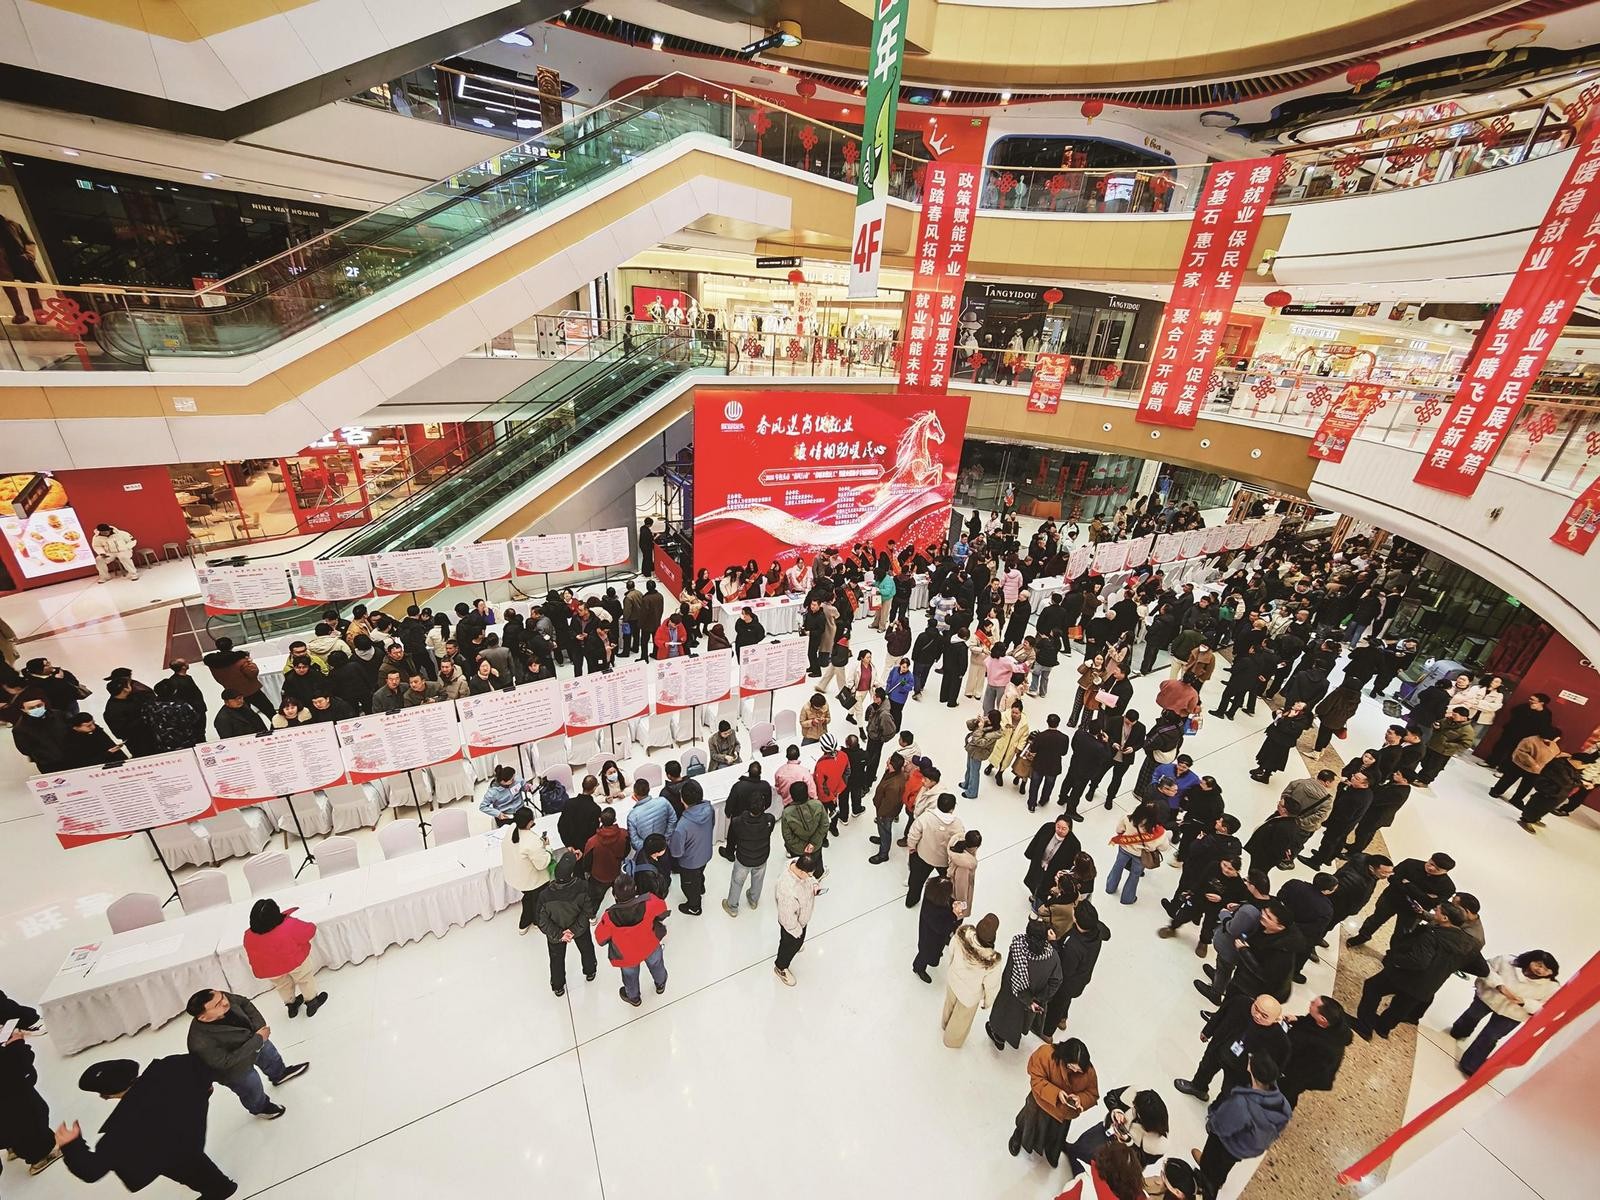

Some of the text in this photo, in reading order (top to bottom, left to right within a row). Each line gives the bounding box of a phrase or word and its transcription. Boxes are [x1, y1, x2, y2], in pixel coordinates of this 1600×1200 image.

[345, 266, 360, 278] 2F
[853, 217, 882, 274] 4F
[905, 169, 947, 387] 马踏春风拓路 就业赋能未来
[929, 172, 974, 388] 政策赋能产业 就业惠泽万家
[1458, 300, 1565, 476] 就业惠民展新篇
